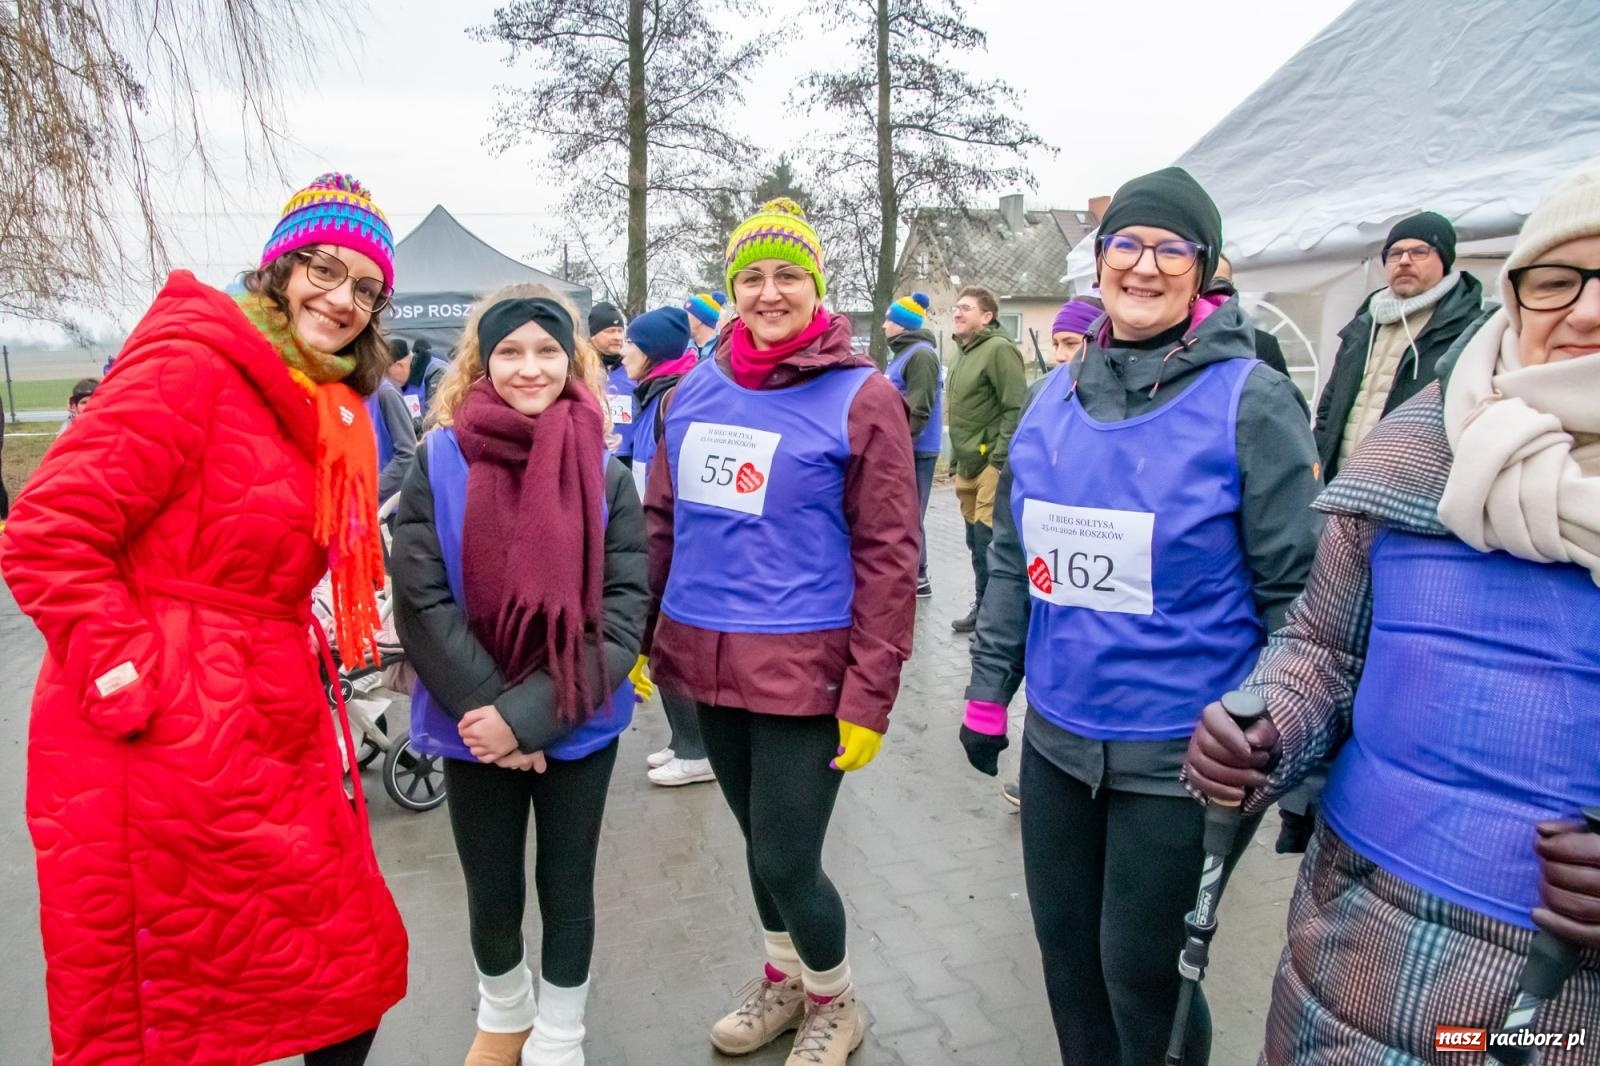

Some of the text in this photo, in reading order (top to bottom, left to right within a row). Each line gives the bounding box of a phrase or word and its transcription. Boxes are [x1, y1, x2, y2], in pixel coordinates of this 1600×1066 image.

[390, 304, 476, 318] OSP ROSZ
[701, 454, 737, 486] 55
[1048, 513, 1114, 529] II BIEG SOŁTYSA
[1041, 523, 1123, 540] 25.01.2026 ROSZKÓW
[1048, 548, 1115, 592] 162
